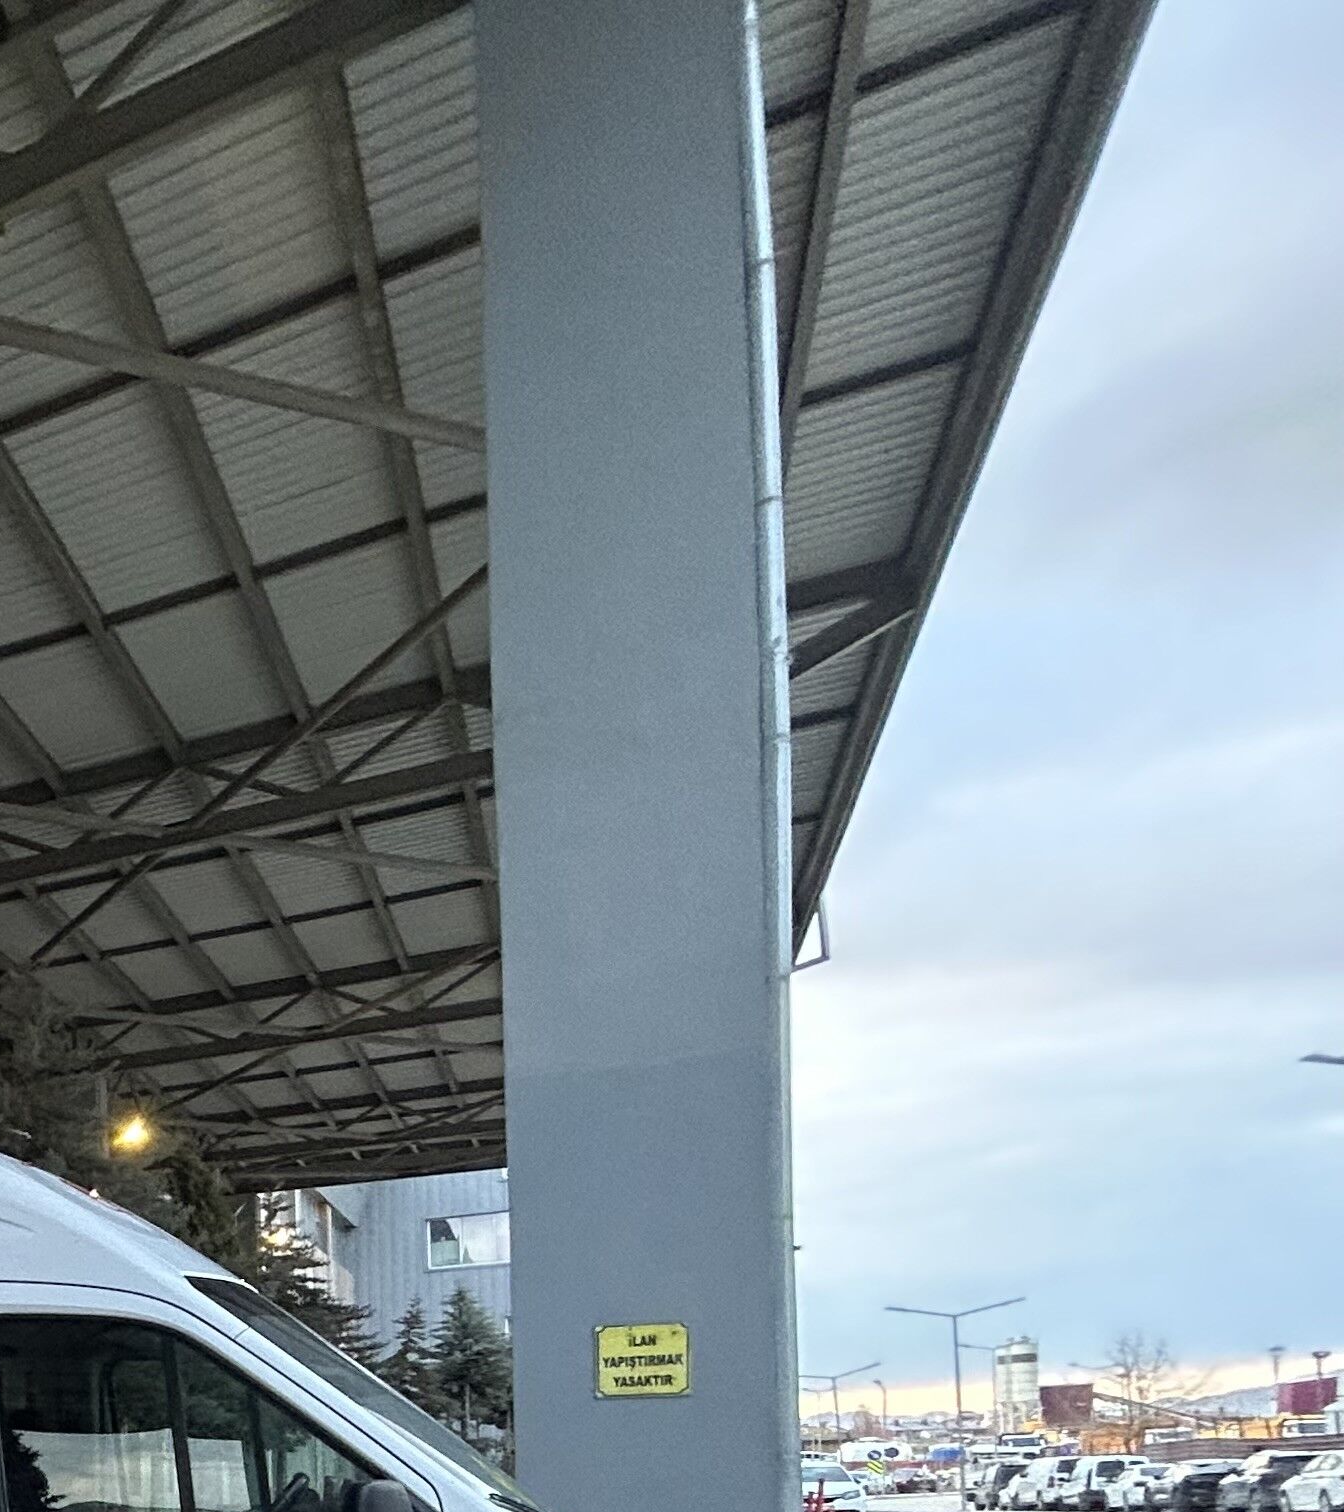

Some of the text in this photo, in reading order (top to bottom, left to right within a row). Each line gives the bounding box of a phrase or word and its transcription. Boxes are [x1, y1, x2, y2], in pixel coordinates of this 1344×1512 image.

[628, 1332, 657, 1348] İLAN
[602, 1353, 684, 1372] YAPIŞTIRMAK
[613, 1374, 674, 1388] YASAKTIR
